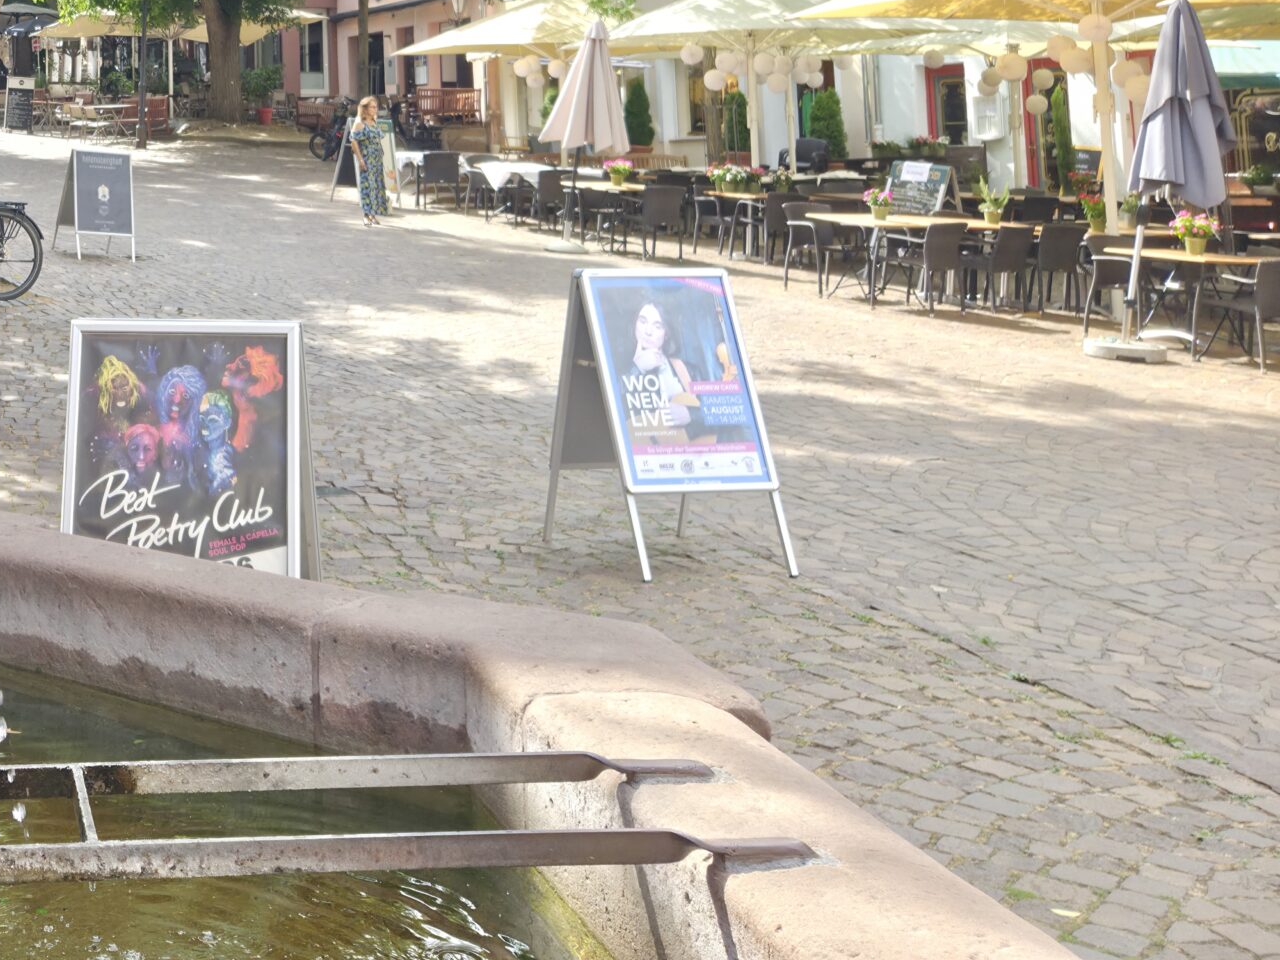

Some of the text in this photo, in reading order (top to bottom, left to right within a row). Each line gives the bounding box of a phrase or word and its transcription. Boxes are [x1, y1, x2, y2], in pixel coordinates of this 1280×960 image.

[626, 392, 670, 409] NEM
[703, 395, 743, 405] SAMSTAG
[629, 409, 674, 427] LIVE
[711, 405, 744, 415] AUGUST
[79, 469, 181, 519] Beat
[106, 487, 273, 559] Poetry Club
[207, 542, 247, 557] SOUL POP
[208, 535, 237, 549] FEMALE
